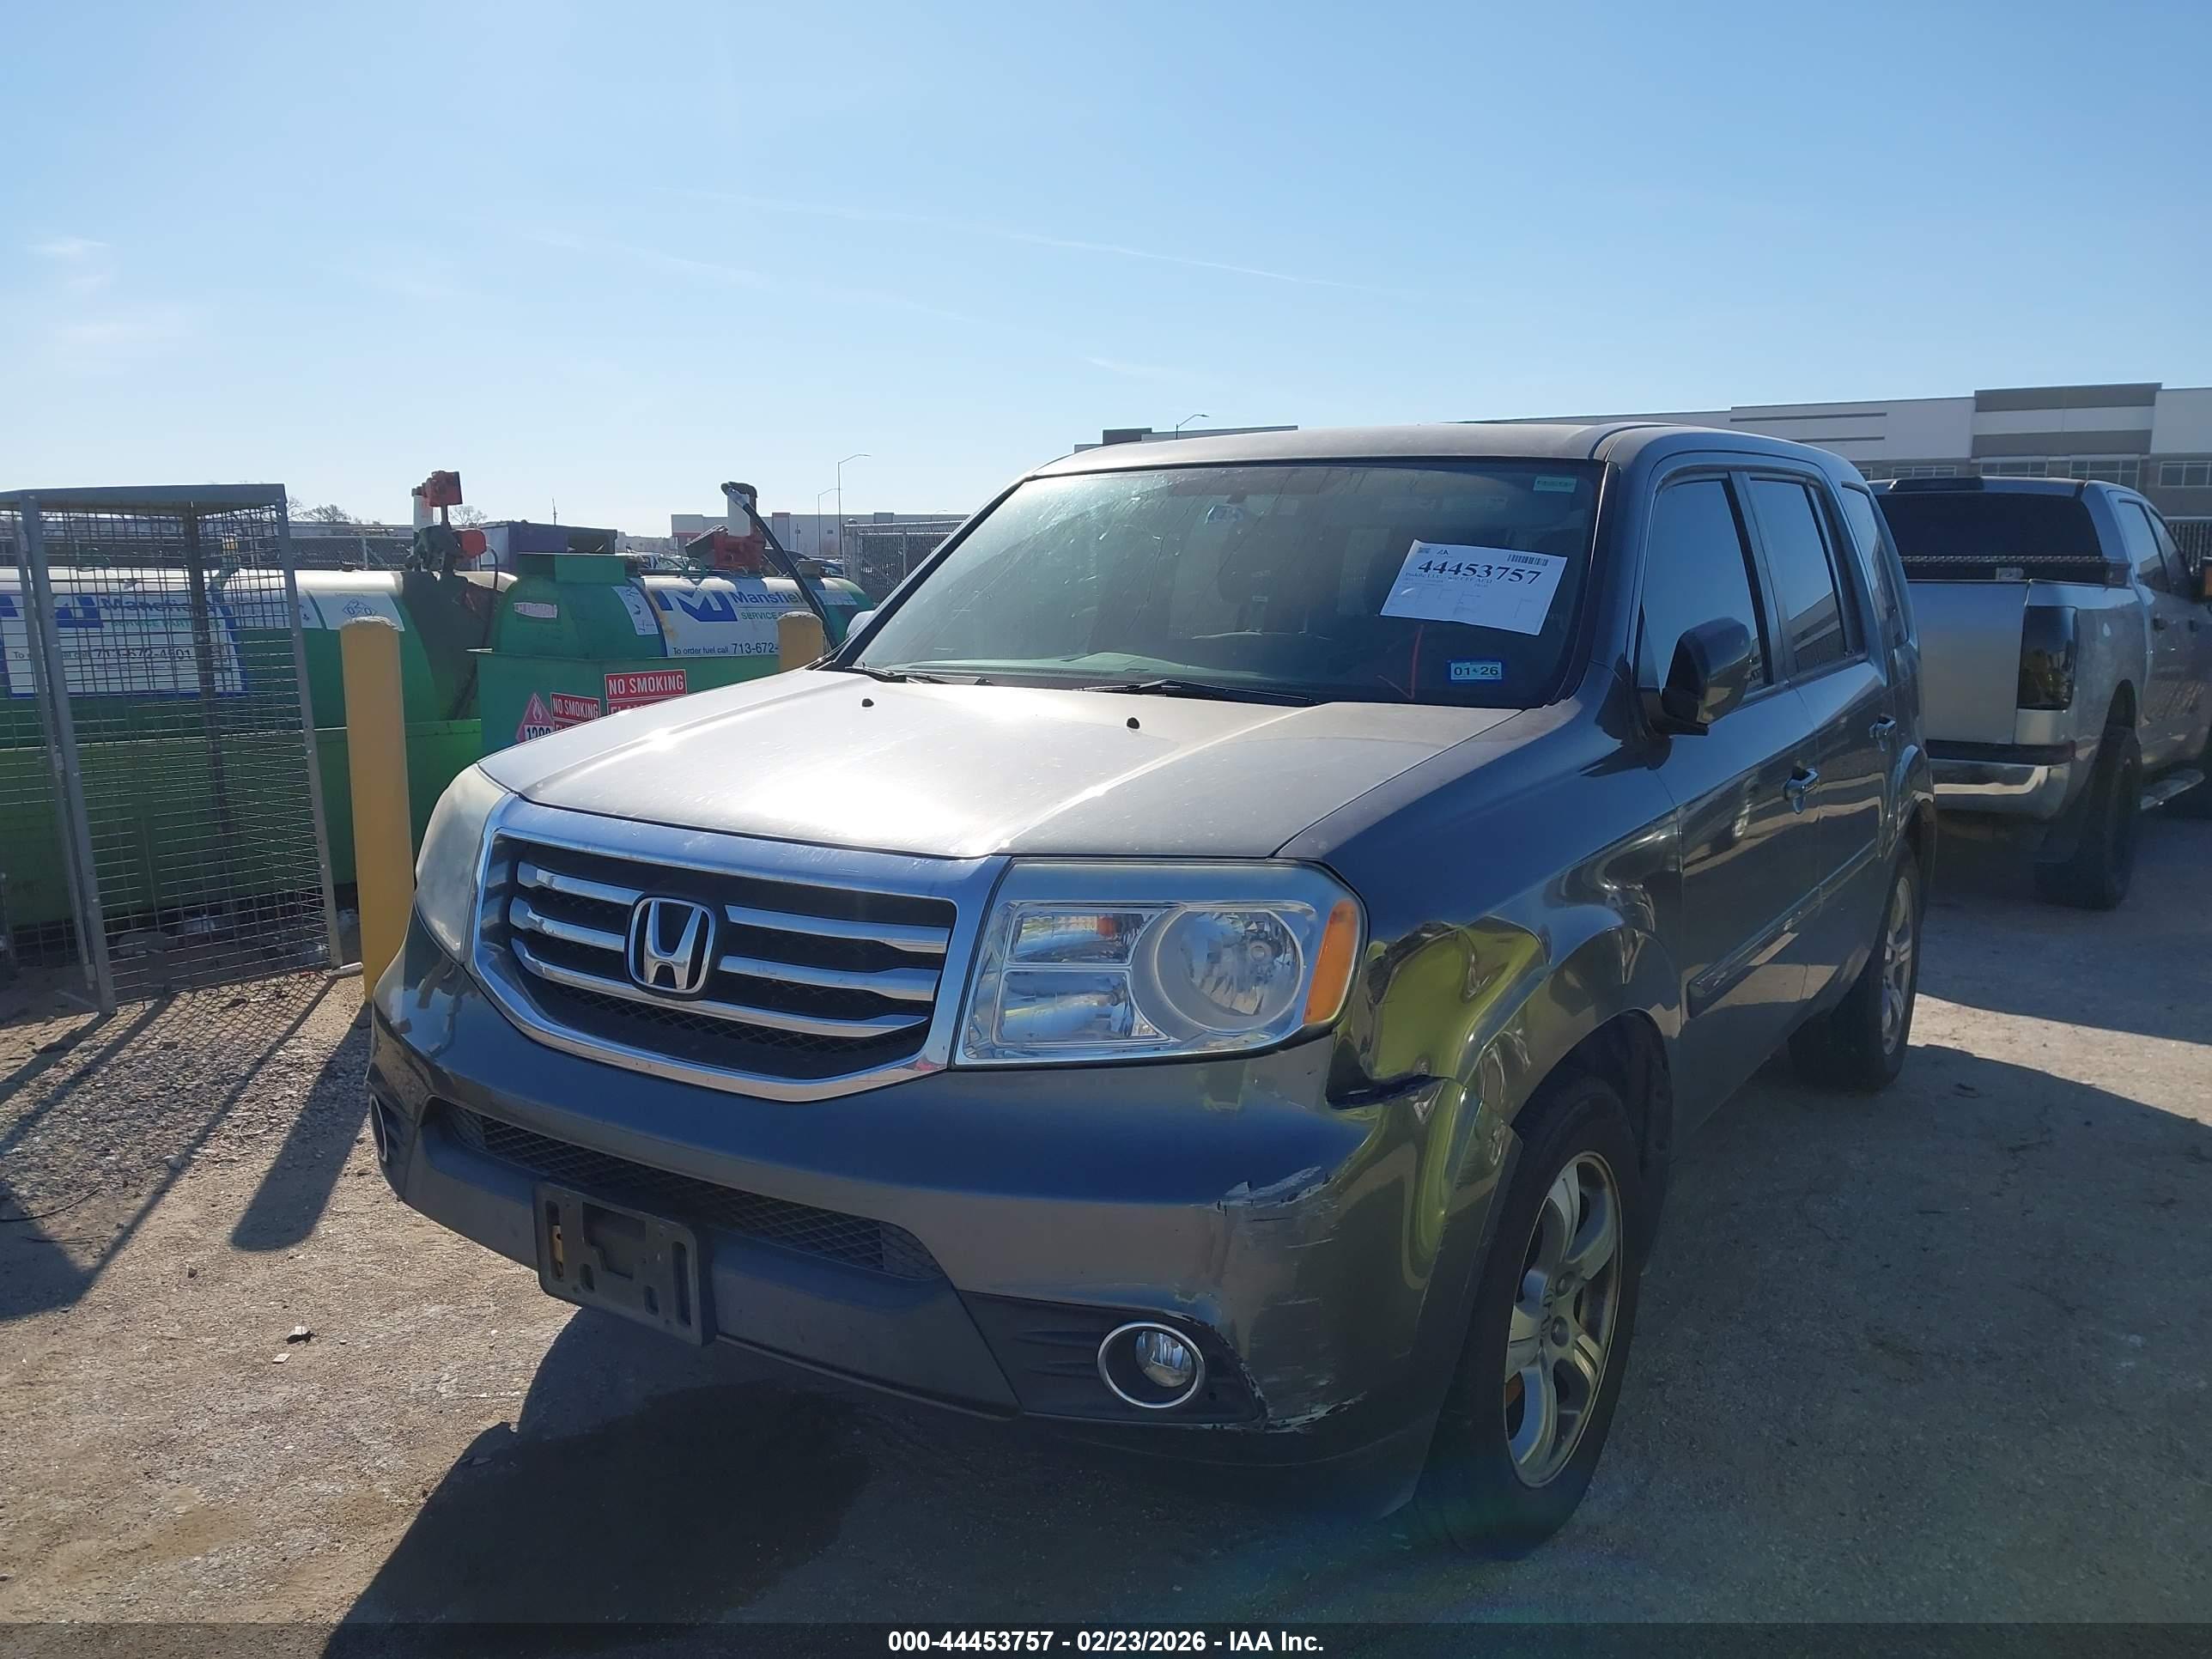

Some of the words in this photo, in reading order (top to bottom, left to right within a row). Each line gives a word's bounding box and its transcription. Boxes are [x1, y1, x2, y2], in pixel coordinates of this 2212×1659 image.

[1418, 560, 1542, 585] 44453757
[729, 591, 804, 604] Mansfiel
[741, 611, 777, 621] SERVICE
[703, 646, 715, 654] fuel
[732, 642, 778, 654] 713-672-
[1454, 666, 1469, 676] 01
[1480, 666, 1498, 676] 26
[608, 678, 625, 695] NO
[629, 675, 684, 695] SMOKING
[552, 698, 563, 714] NO
[564, 701, 599, 719] SMOKING
